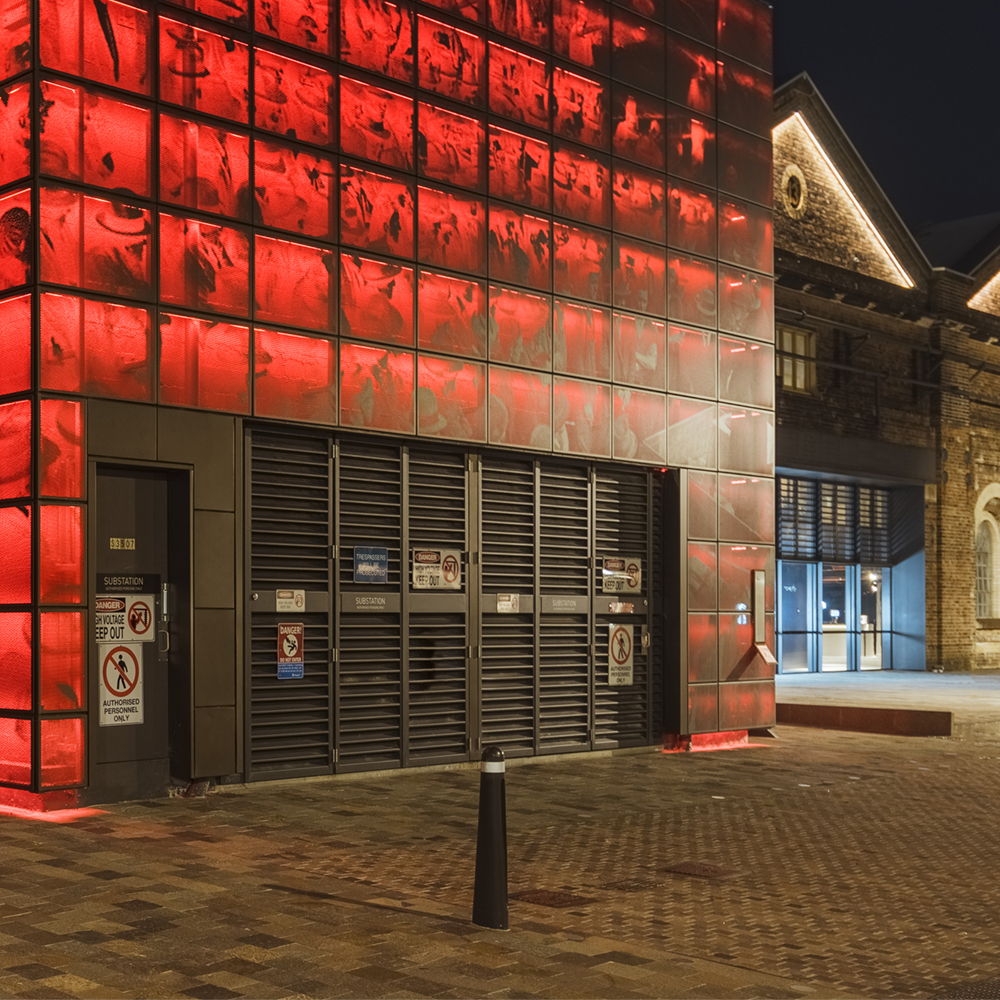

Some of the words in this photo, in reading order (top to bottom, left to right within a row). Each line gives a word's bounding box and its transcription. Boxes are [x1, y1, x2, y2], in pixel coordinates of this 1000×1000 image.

[110, 539, 134, 549] S3507
[356, 553, 387, 561] TRESPASSERS
[418, 553, 438, 561] DANGER
[104, 576, 144, 586] SUBSTATION
[415, 575, 428, 586] KEEP
[429, 575, 440, 586] OUT
[355, 597, 386, 605] SUBSTATION
[552, 599, 577, 607] SUBSTATION
[103, 614, 125, 625] VOLTAGE
[96, 627, 109, 640] EEP
[110, 627, 125, 640] OUT
[280, 626, 302, 635] DANGER!
[103, 698, 140, 706] AUTHORISED
[104, 706, 139, 715] PERSONNEL
